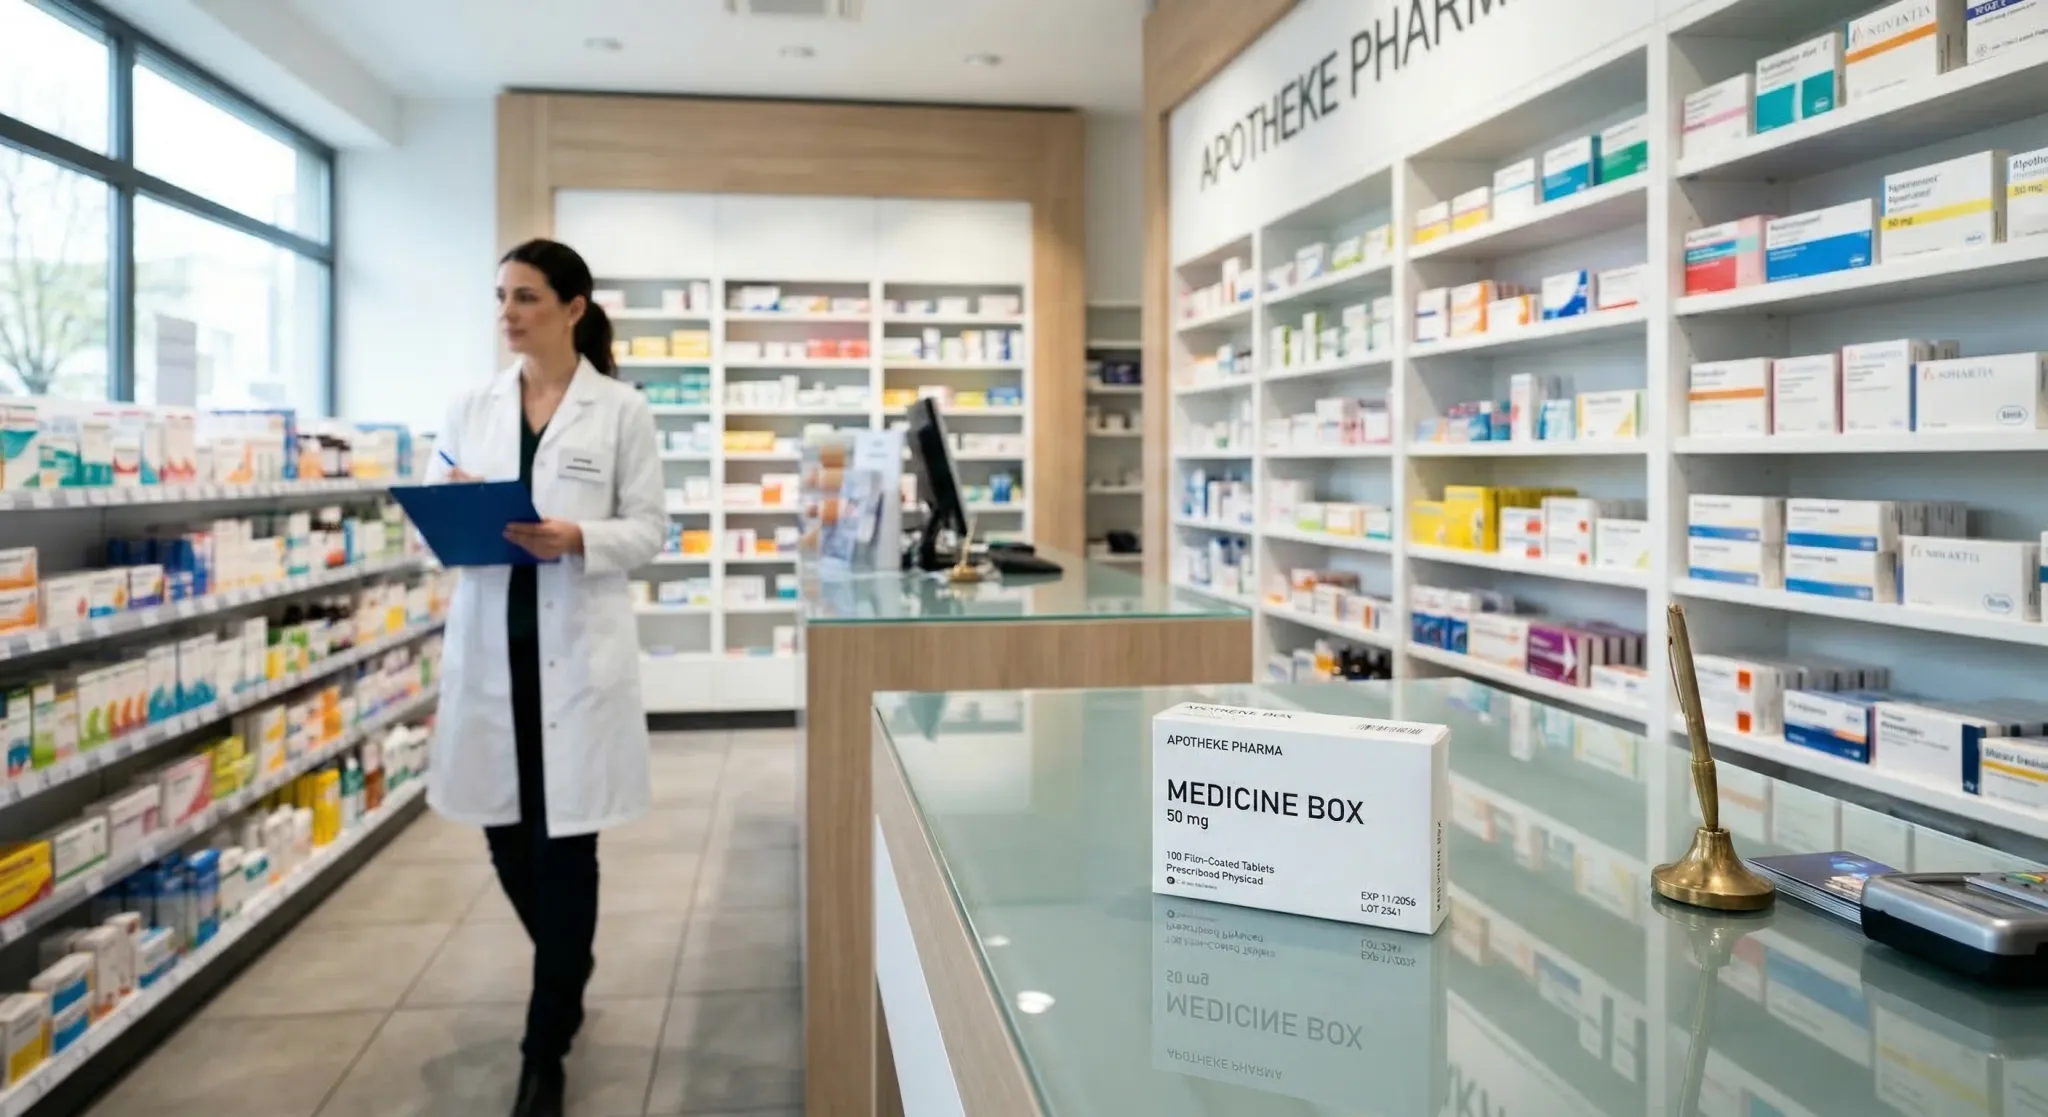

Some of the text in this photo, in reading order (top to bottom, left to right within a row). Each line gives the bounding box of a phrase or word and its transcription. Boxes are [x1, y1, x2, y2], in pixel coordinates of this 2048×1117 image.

[1201, 51, 1339, 192] APOTHEKE
[1167, 734, 1283, 756] APOTHEKE PHARMA
[1168, 778, 1364, 825] MEDICINE BOX
[1167, 809, 1209, 830] 50 mg
[1166, 851, 1182, 860] 100
[1242, 861, 1275, 874] Tablets
[1222, 871, 1264, 886] Physicad
[1361, 891, 1379, 901] EXP
[1361, 903, 1380, 914] LOT
